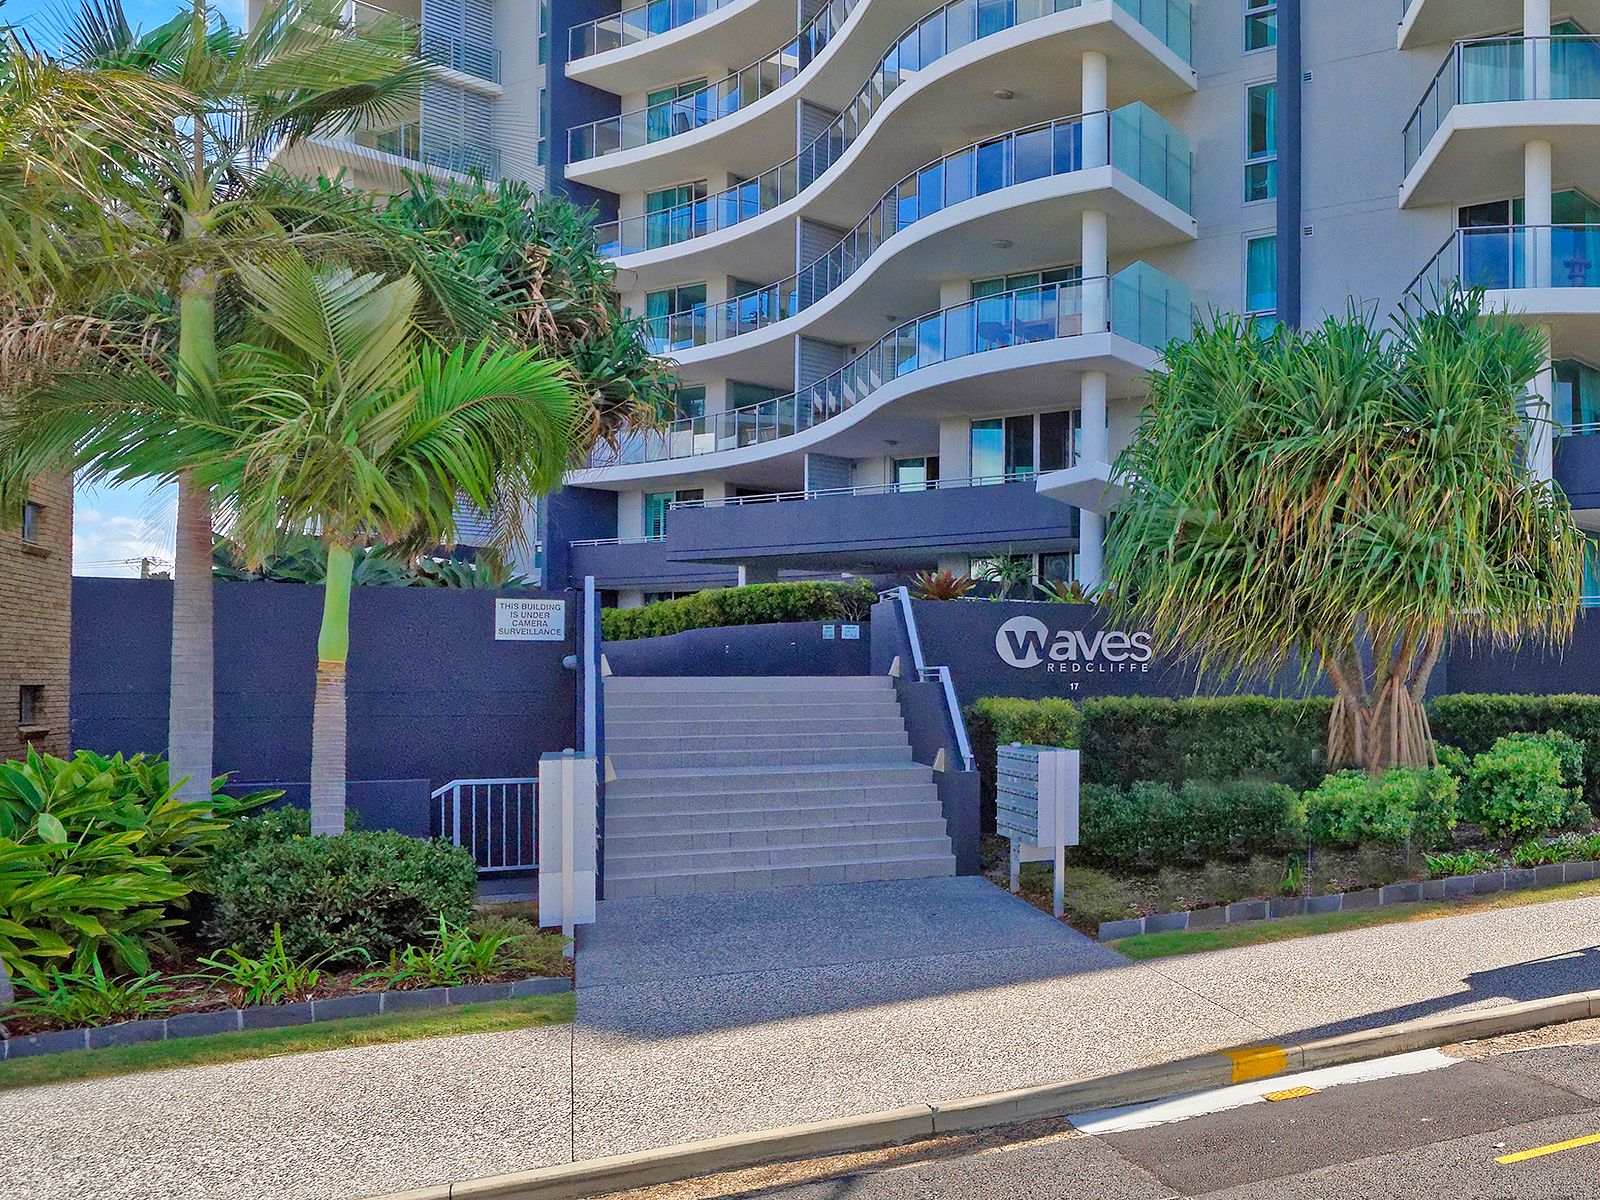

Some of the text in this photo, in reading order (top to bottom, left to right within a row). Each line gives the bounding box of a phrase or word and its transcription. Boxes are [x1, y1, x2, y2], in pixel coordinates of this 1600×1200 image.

[499, 602, 561, 611] THIS BUILDING
[520, 611, 550, 619] UNDER
[511, 619, 549, 627] CAMERA
[498, 627, 561, 636] SURVEILLANCE
[1047, 663, 1149, 672] REDCLIFFE
[1069, 682, 1079, 690] 17
